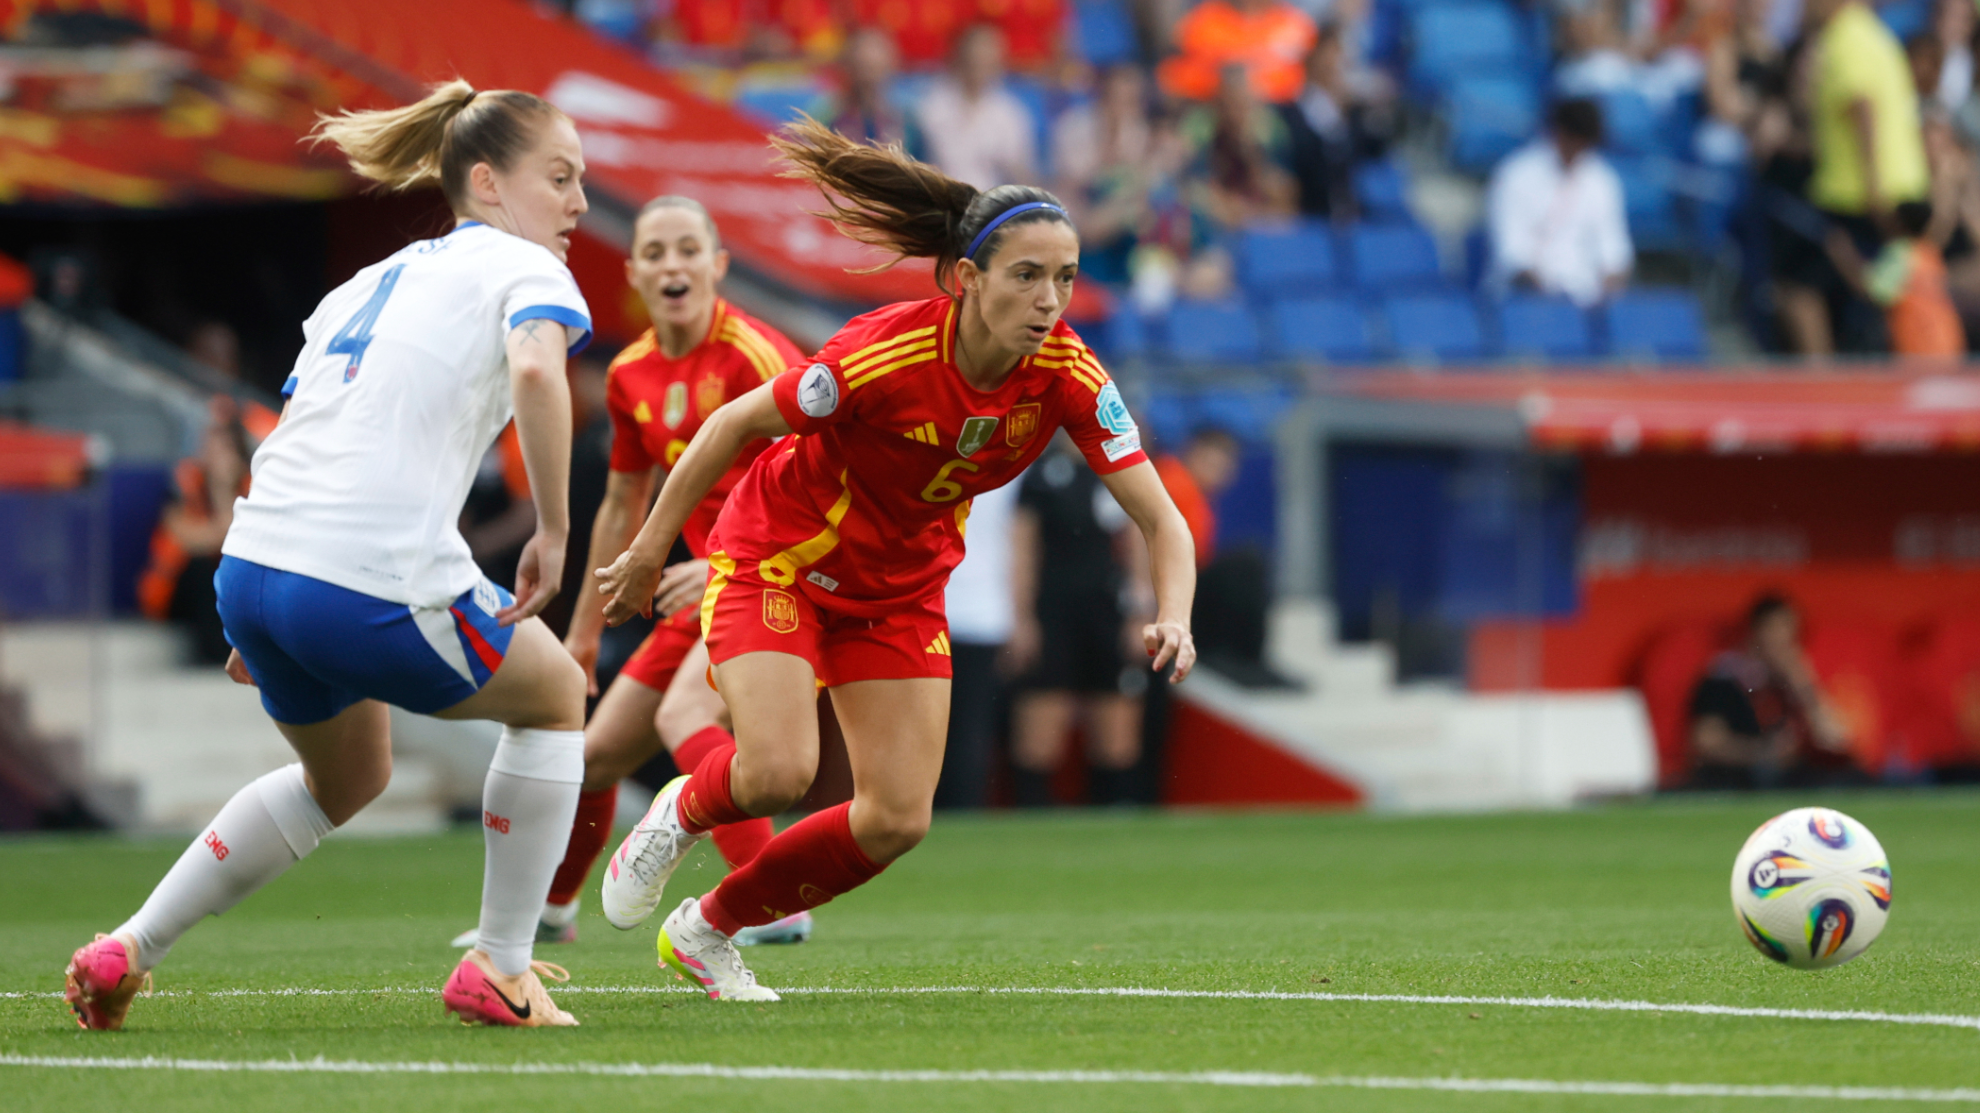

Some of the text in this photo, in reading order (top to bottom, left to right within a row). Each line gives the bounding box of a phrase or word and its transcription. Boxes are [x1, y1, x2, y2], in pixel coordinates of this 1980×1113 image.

[325, 263, 407, 384] 4
[920, 459, 979, 502] 6
[484, 810, 511, 835] ENG
[204, 829, 230, 862] ENG
